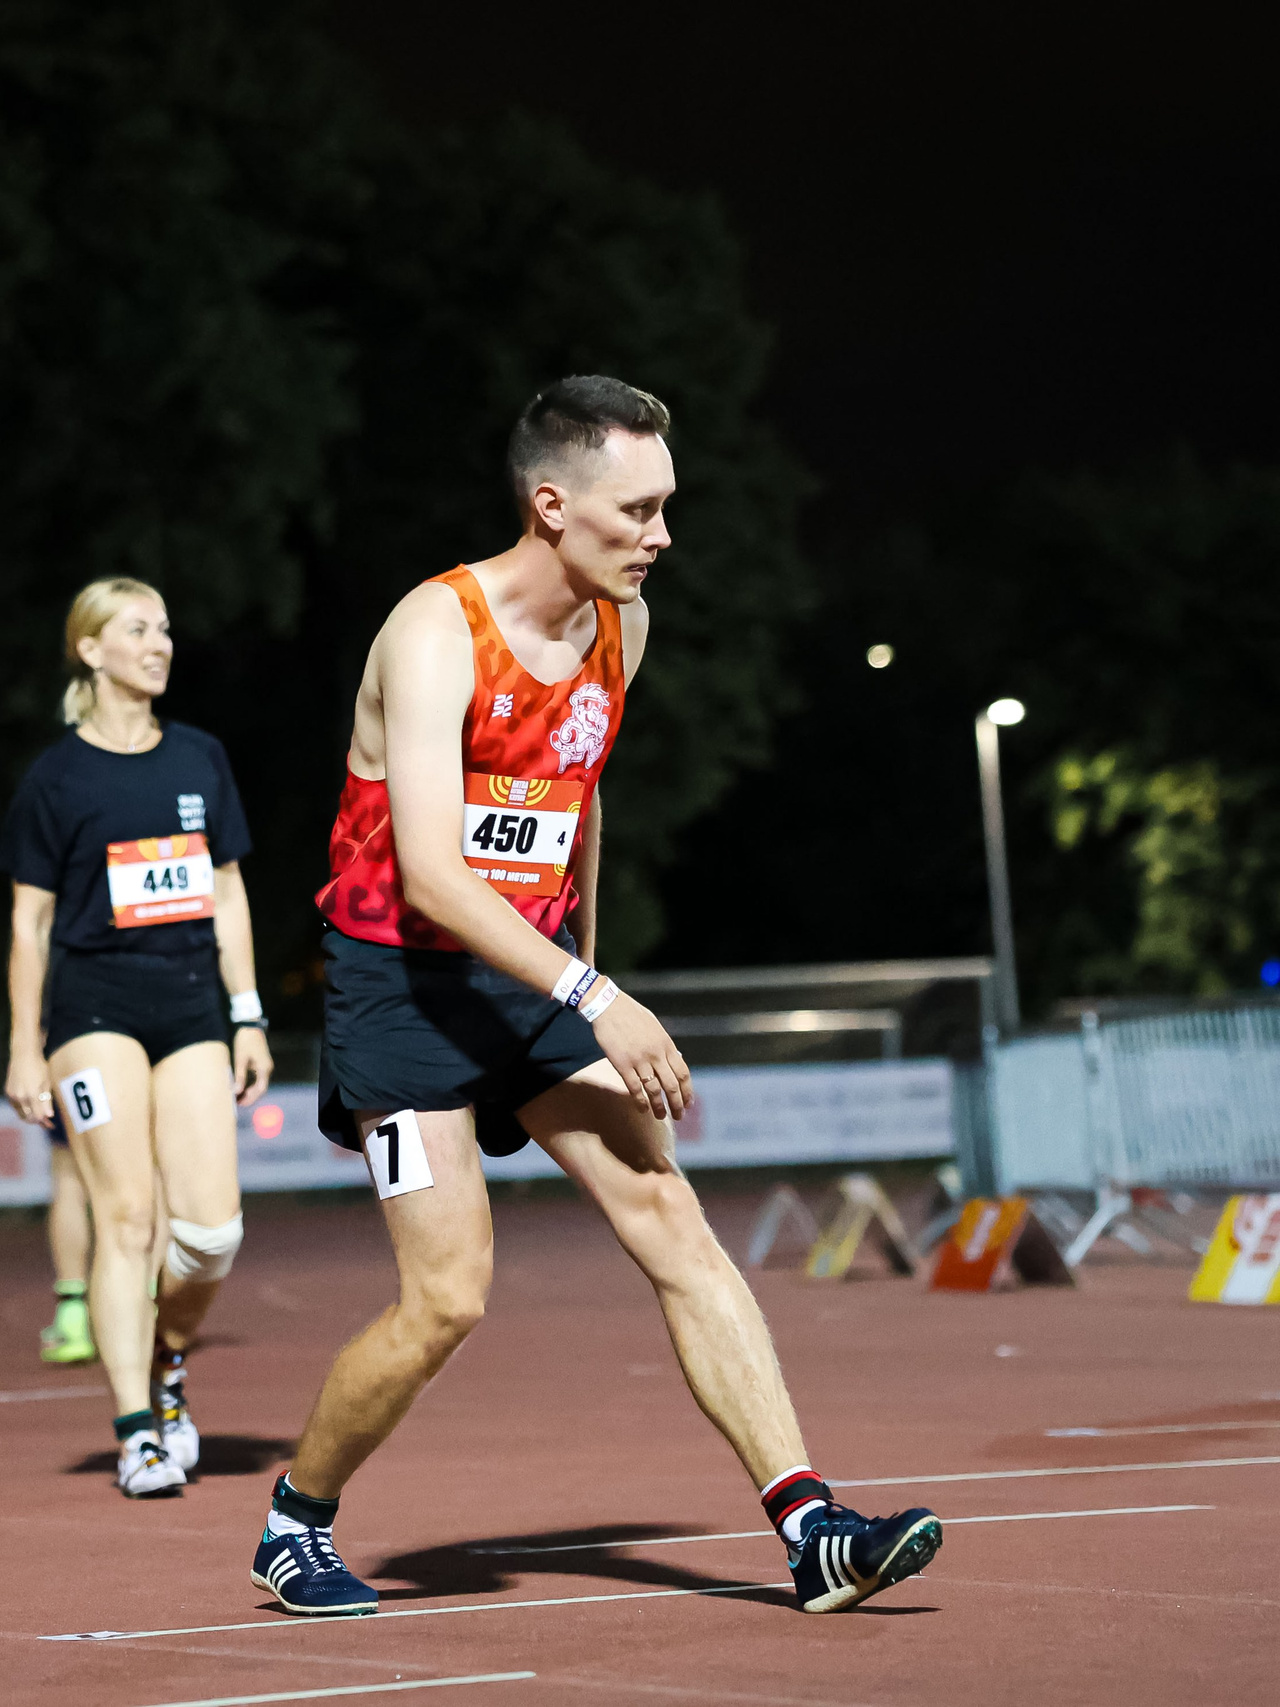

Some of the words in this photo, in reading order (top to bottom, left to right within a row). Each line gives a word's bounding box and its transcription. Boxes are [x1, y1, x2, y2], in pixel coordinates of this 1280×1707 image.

[472, 813, 538, 854] 450
[557, 831, 566, 846] 4
[144, 866, 188, 893] 449
[490, 868, 507, 881] 100
[506, 871, 541, 884] метров
[73, 1081, 93, 1120] 6
